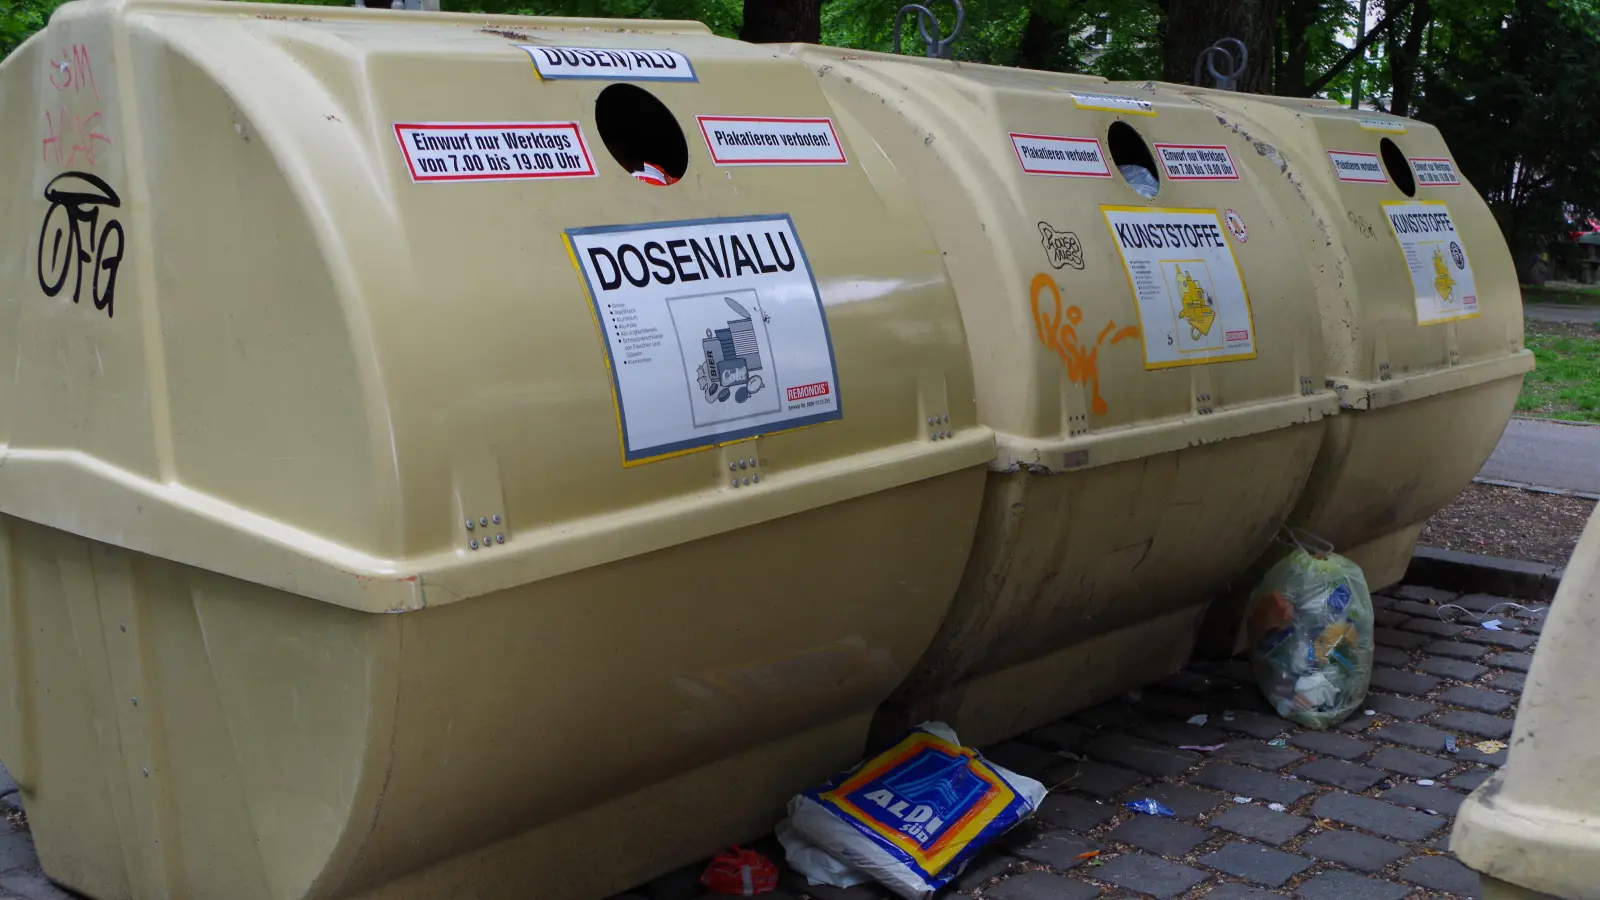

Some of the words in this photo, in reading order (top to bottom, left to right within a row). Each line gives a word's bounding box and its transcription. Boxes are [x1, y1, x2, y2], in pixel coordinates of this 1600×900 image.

[539, 48, 677, 71] DOSEN/ALU
[411, 132, 473, 150] Einwurf
[474, 136, 500, 150] nur
[501, 132, 572, 151] Werktags
[714, 130, 780, 147] Plakatieren
[779, 132, 831, 147] verboten!
[417, 157, 449, 173] von
[448, 154, 484, 172] 7.00
[485, 154, 511, 171] bis
[512, 153, 554, 171] 19.00
[554, 152, 582, 169] Uhr
[1021, 145, 1066, 161] Plakatieren
[1064, 148, 1100, 163] verboten!
[1162, 149, 1188, 161] Einwurf
[1197, 150, 1227, 163] Werktags
[1390, 213, 1455, 233] KUNSTSTOFFE
[1115, 223, 1225, 249] KUNSTSTOFFE
[587, 231, 796, 291] DOSEN/ALU
[706, 350, 718, 378] BIER
[722, 366, 748, 386] Cola
[787, 383, 826, 400] REMONDIS
[863, 789, 945, 835] ALDI
[898, 823, 929, 843] SÜD
